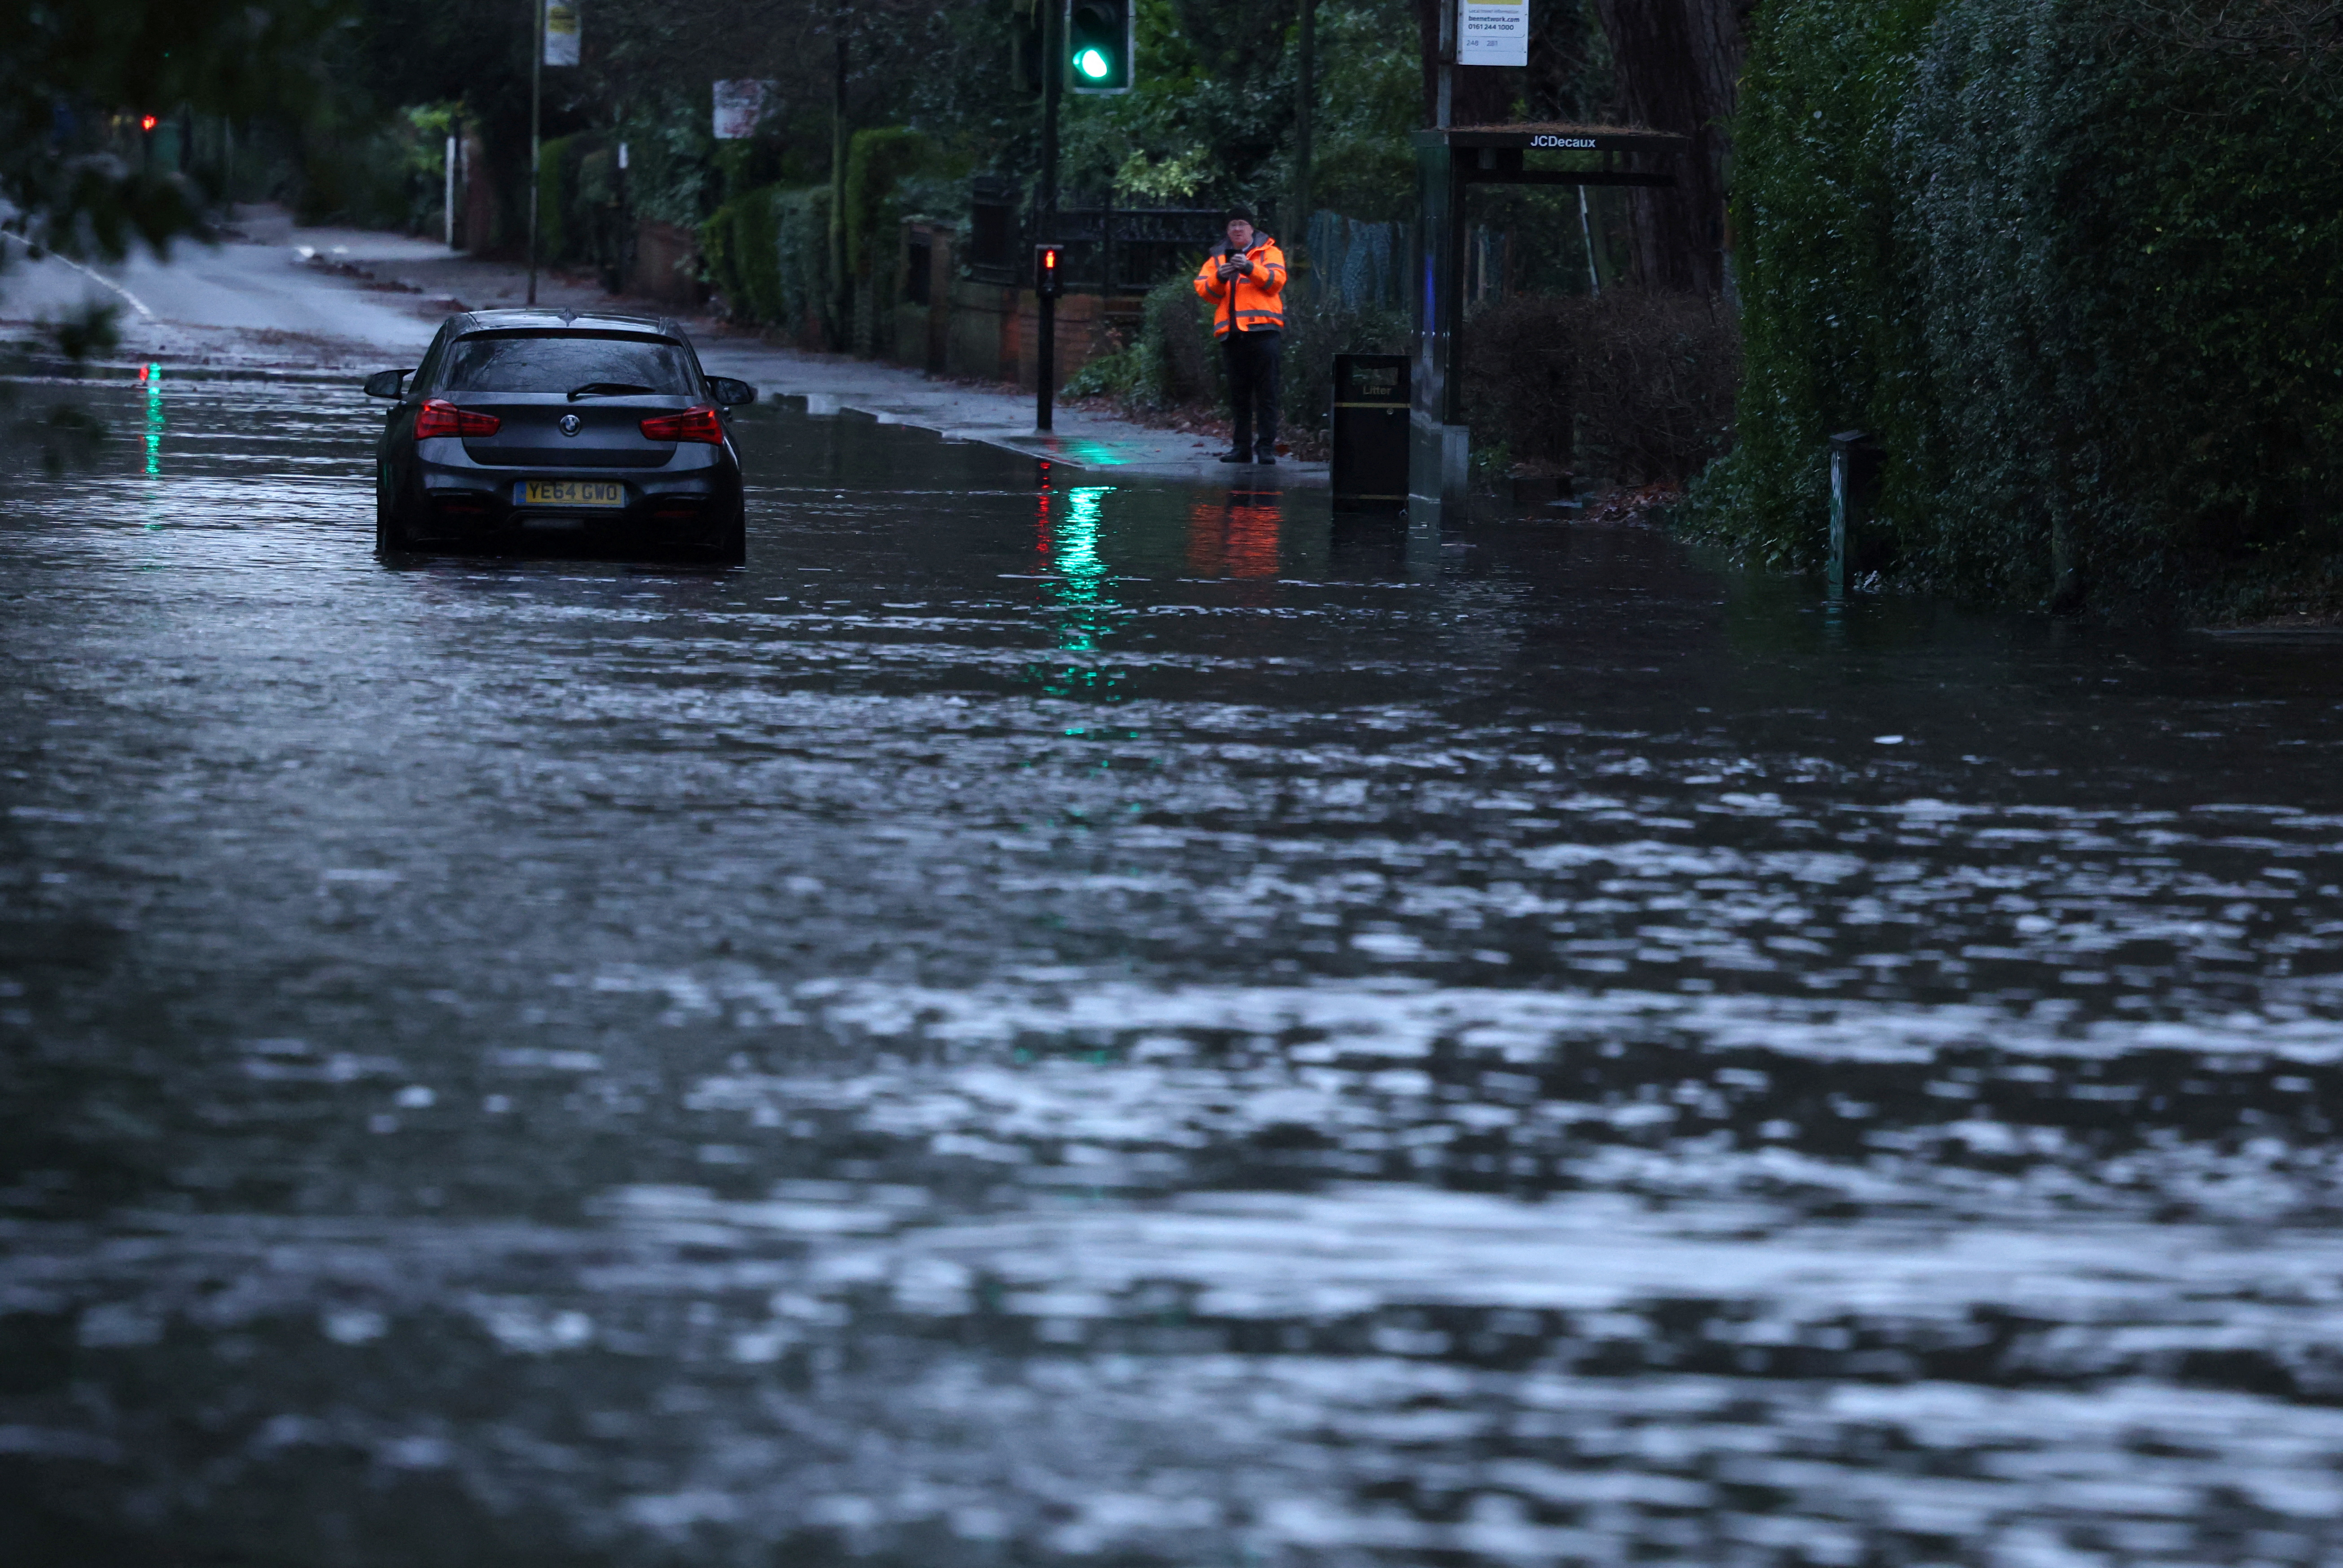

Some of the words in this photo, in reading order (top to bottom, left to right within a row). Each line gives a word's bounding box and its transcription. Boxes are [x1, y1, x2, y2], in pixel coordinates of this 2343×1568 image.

[1530, 135, 1596, 148] JCDecaux
[1363, 385, 1391, 394] Litter
[529, 483, 576, 499] YE64
[582, 484, 617, 501] GWO
